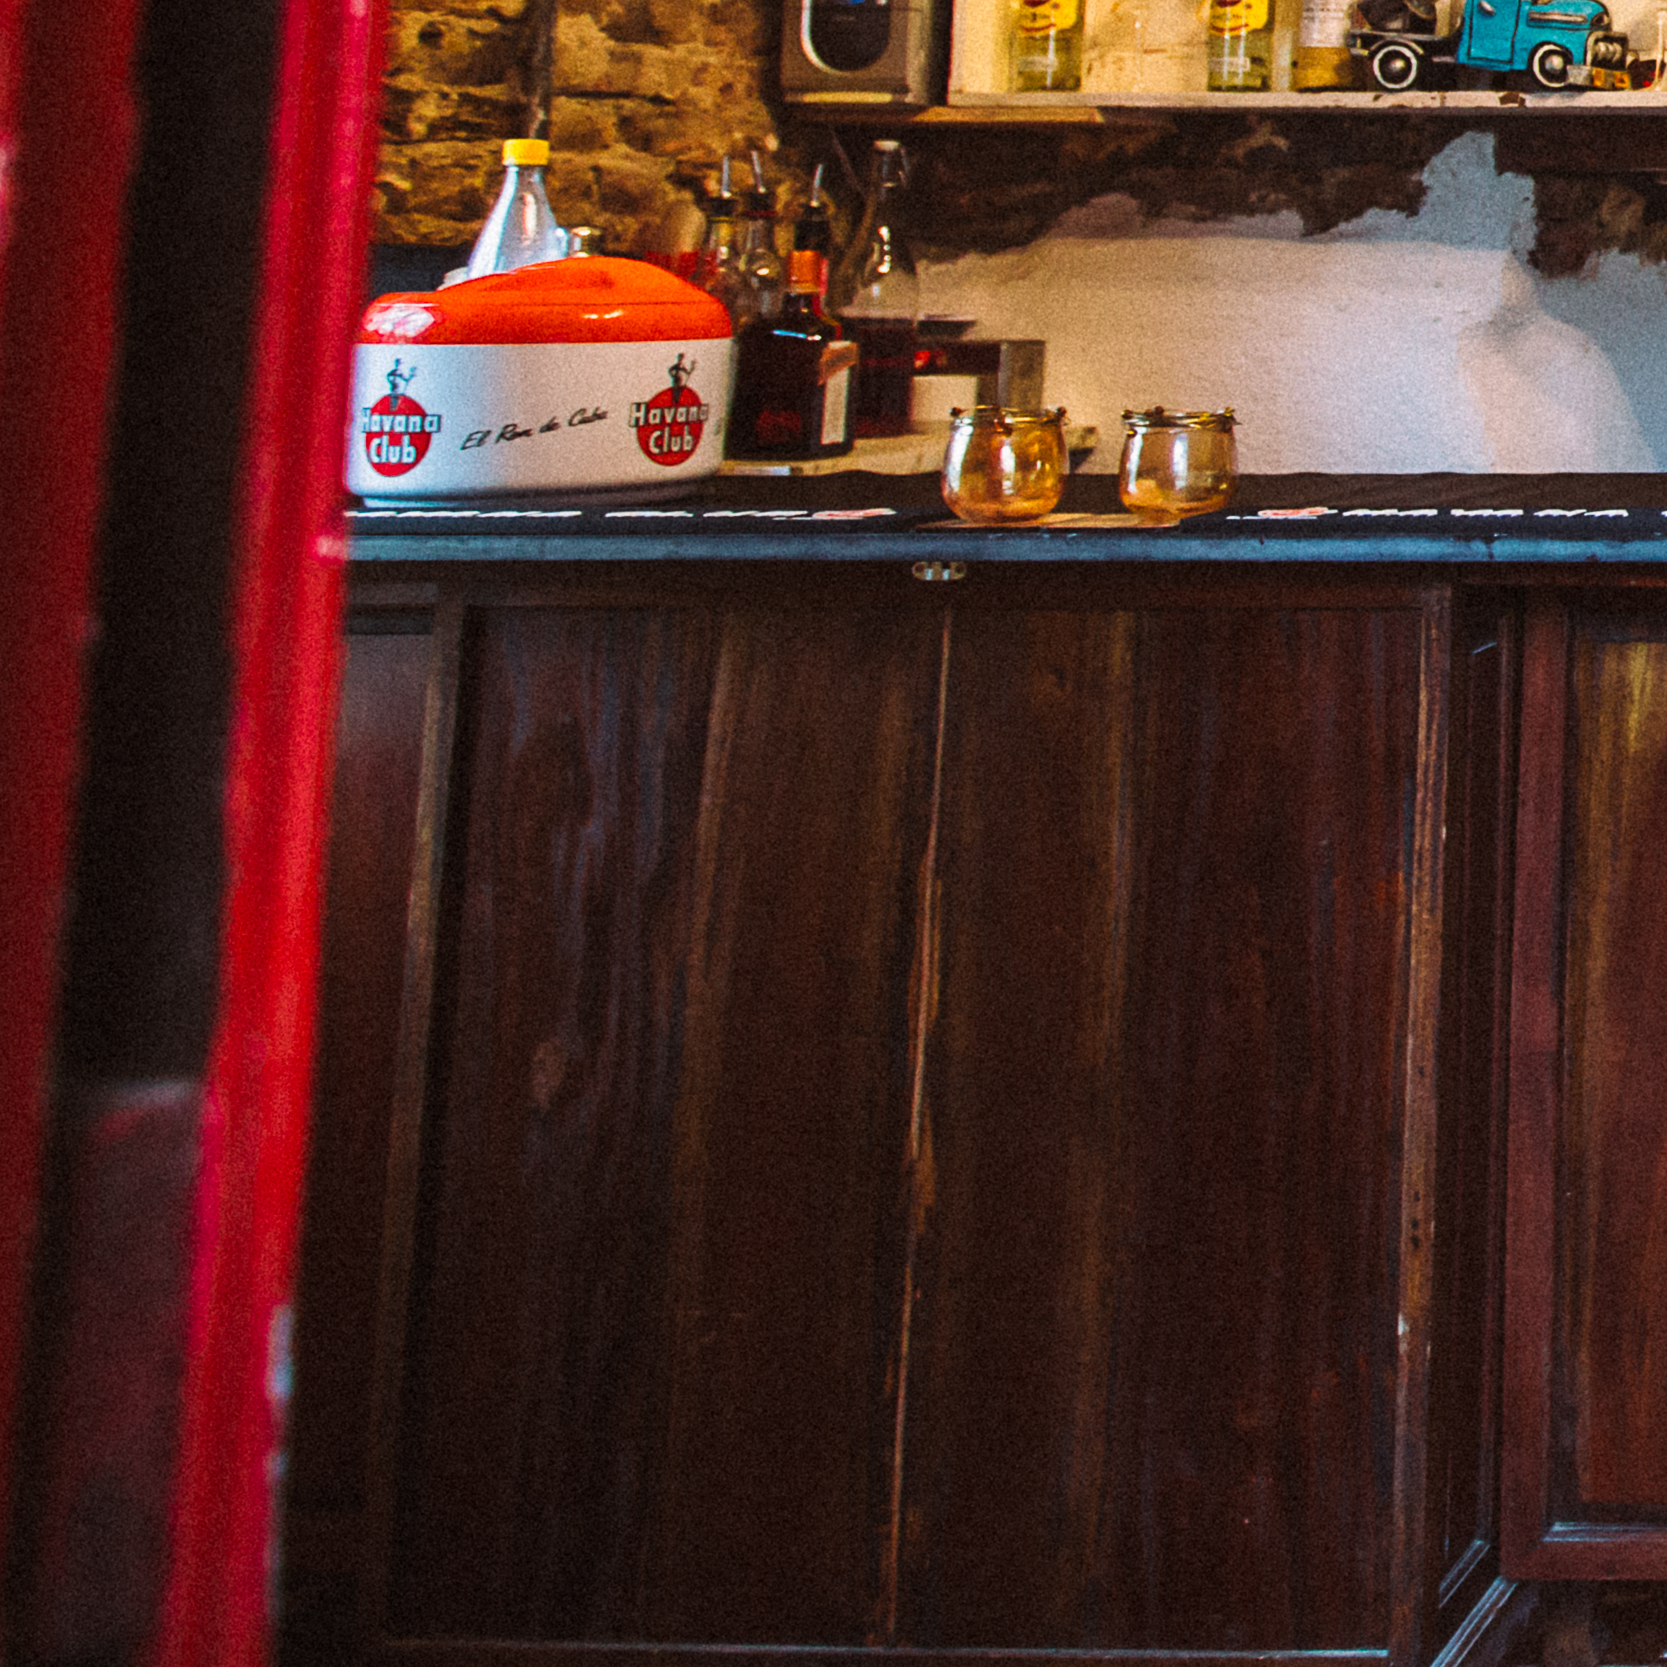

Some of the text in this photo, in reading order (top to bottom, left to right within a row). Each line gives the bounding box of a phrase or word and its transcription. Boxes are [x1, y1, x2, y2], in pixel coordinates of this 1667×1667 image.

[361, 407, 442, 433] Havana
[628, 402, 709, 428] Havana
[370, 433, 417, 464] Club
[460, 430, 492, 451] El
[649, 424, 694, 454] Club
